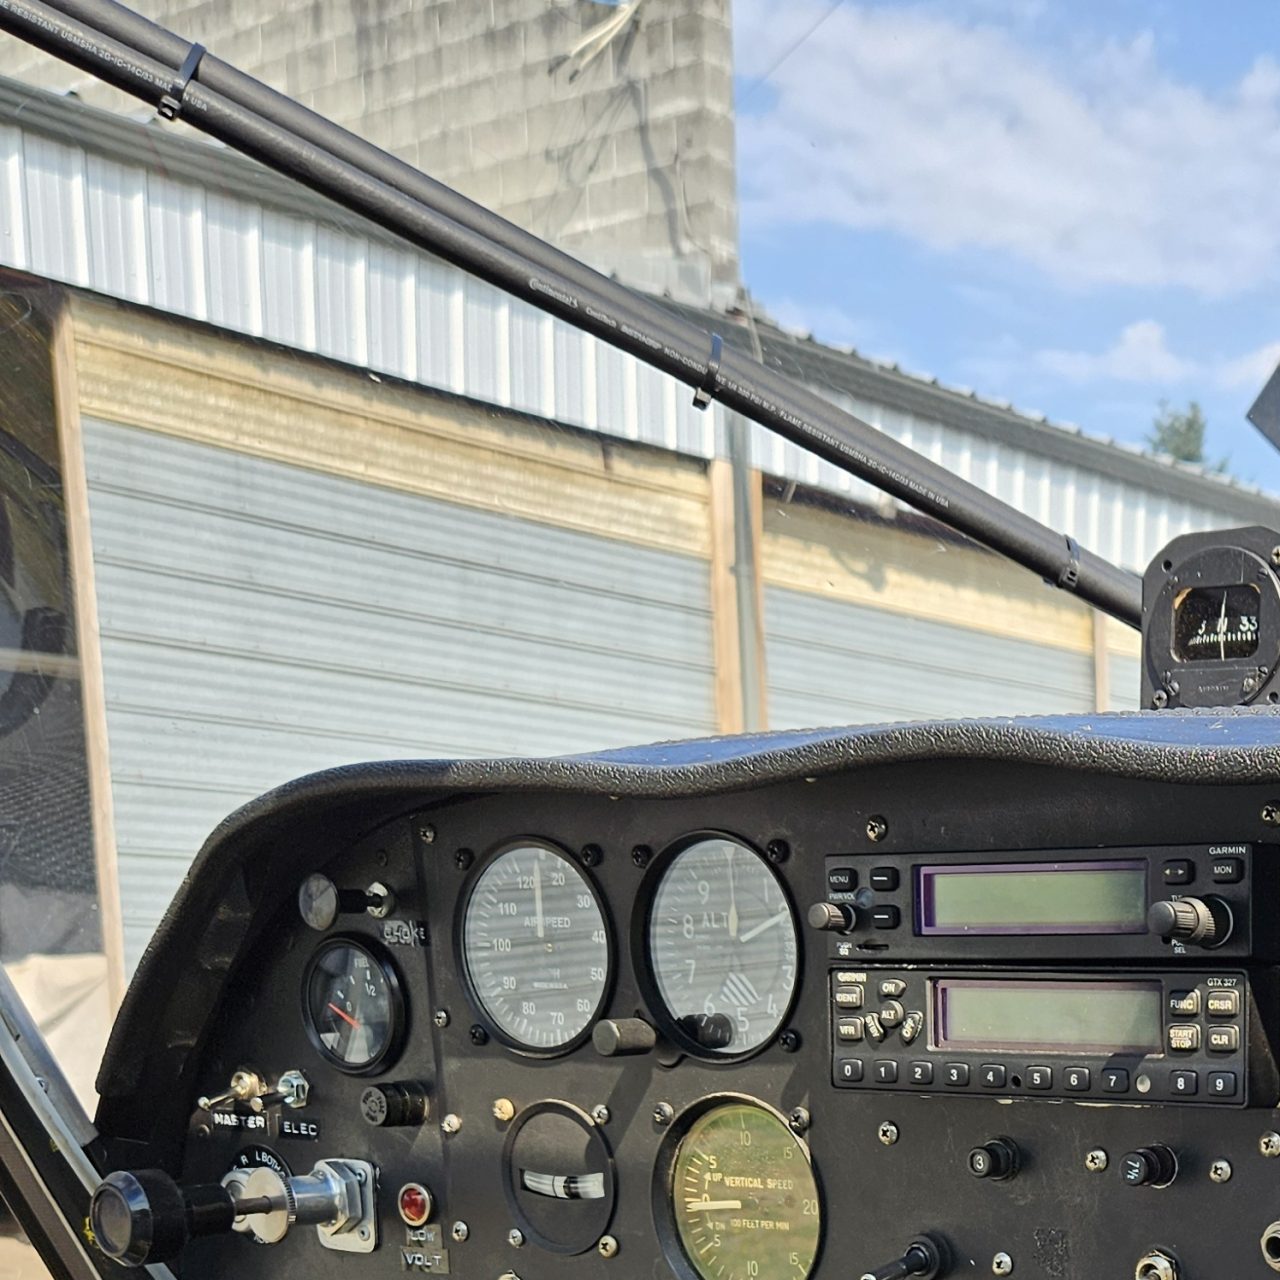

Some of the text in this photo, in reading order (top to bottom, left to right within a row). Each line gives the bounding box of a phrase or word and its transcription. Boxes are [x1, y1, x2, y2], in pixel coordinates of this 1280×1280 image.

[1239, 615, 1258, 631] 33
[1209, 846, 1246, 855] GARMIN
[1214, 866, 1232, 874] MON
[517, 876, 534, 889] 120
[552, 873, 565, 886] 20
[829, 875, 849, 884] MENU
[698, 880, 710, 905] 9
[577, 895, 591, 908] 30
[500, 903, 517, 915] 110
[683, 914, 694, 939] 8
[702, 912, 728, 929] ALT
[383, 925, 426, 941] CHOKE
[592, 930, 606, 944] 40
[493, 939, 511, 951] 100
[590, 968, 604, 981] 50
[685, 960, 696, 984] 7
[782, 966, 794, 990] 3
[503, 977, 516, 989] 90
[882, 983, 895, 993] ON
[1207, 978, 1237, 986] GTX 327
[836, 993, 857, 1003] IDENT
[522, 1002, 536, 1015] 80
[577, 999, 590, 1012] 60
[704, 994, 715, 1017] 6
[767, 994, 779, 1017] 4
[1170, 1000, 1194, 1010] FUNC
[1208, 1000, 1232, 1010] CRSR
[550, 1012, 564, 1025] 70
[737, 1007, 749, 1032] 5
[882, 1010, 895, 1020] ALT
[840, 1026, 855, 1035] VFR
[1170, 1030, 1194, 1039] START
[1171, 1039, 1192, 1049] STOP
[1211, 1034, 1229, 1045] CLR
[844, 1065, 852, 1077] 0
[879, 1067, 885, 1077] 1
[914, 1068, 922, 1079] 2
[950, 1069, 958, 1080] 3
[987, 1071, 994, 1082] 4
[1033, 1072, 1041, 1084] 5
[1070, 1074, 1078, 1085] 6
[1109, 1076, 1116, 1087] 7
[1177, 1078, 1185, 1090] 8
[1216, 1079, 1224, 1090] 9
[213, 1113, 265, 1129] MASTER
[283, 1121, 318, 1136] ELEC
[740, 1131, 751, 1146] 10
[255, 1150, 262, 1161] L
[784, 1147, 793, 1159] 15
[240, 1154, 249, 1166] R
[261, 1152, 281, 1172] BOTH
[709, 1156, 717, 1169] 5
[976, 1156, 984, 1169] 3
[712, 1172, 723, 1182] UP
[724, 1176, 794, 1190] VERTICAL SPEED
[803, 1200, 818, 1216] 20
[742, 1219, 759, 1229] FEET
[761, 1220, 774, 1230] PER
[776, 1221, 790, 1231] MIN
[408, 1230, 435, 1243] LOW
[714, 1234, 721, 1247] 5
[406, 1253, 442, 1267] VOLT
[789, 1253, 799, 1265] 15
[747, 1261, 758, 1276] 10
